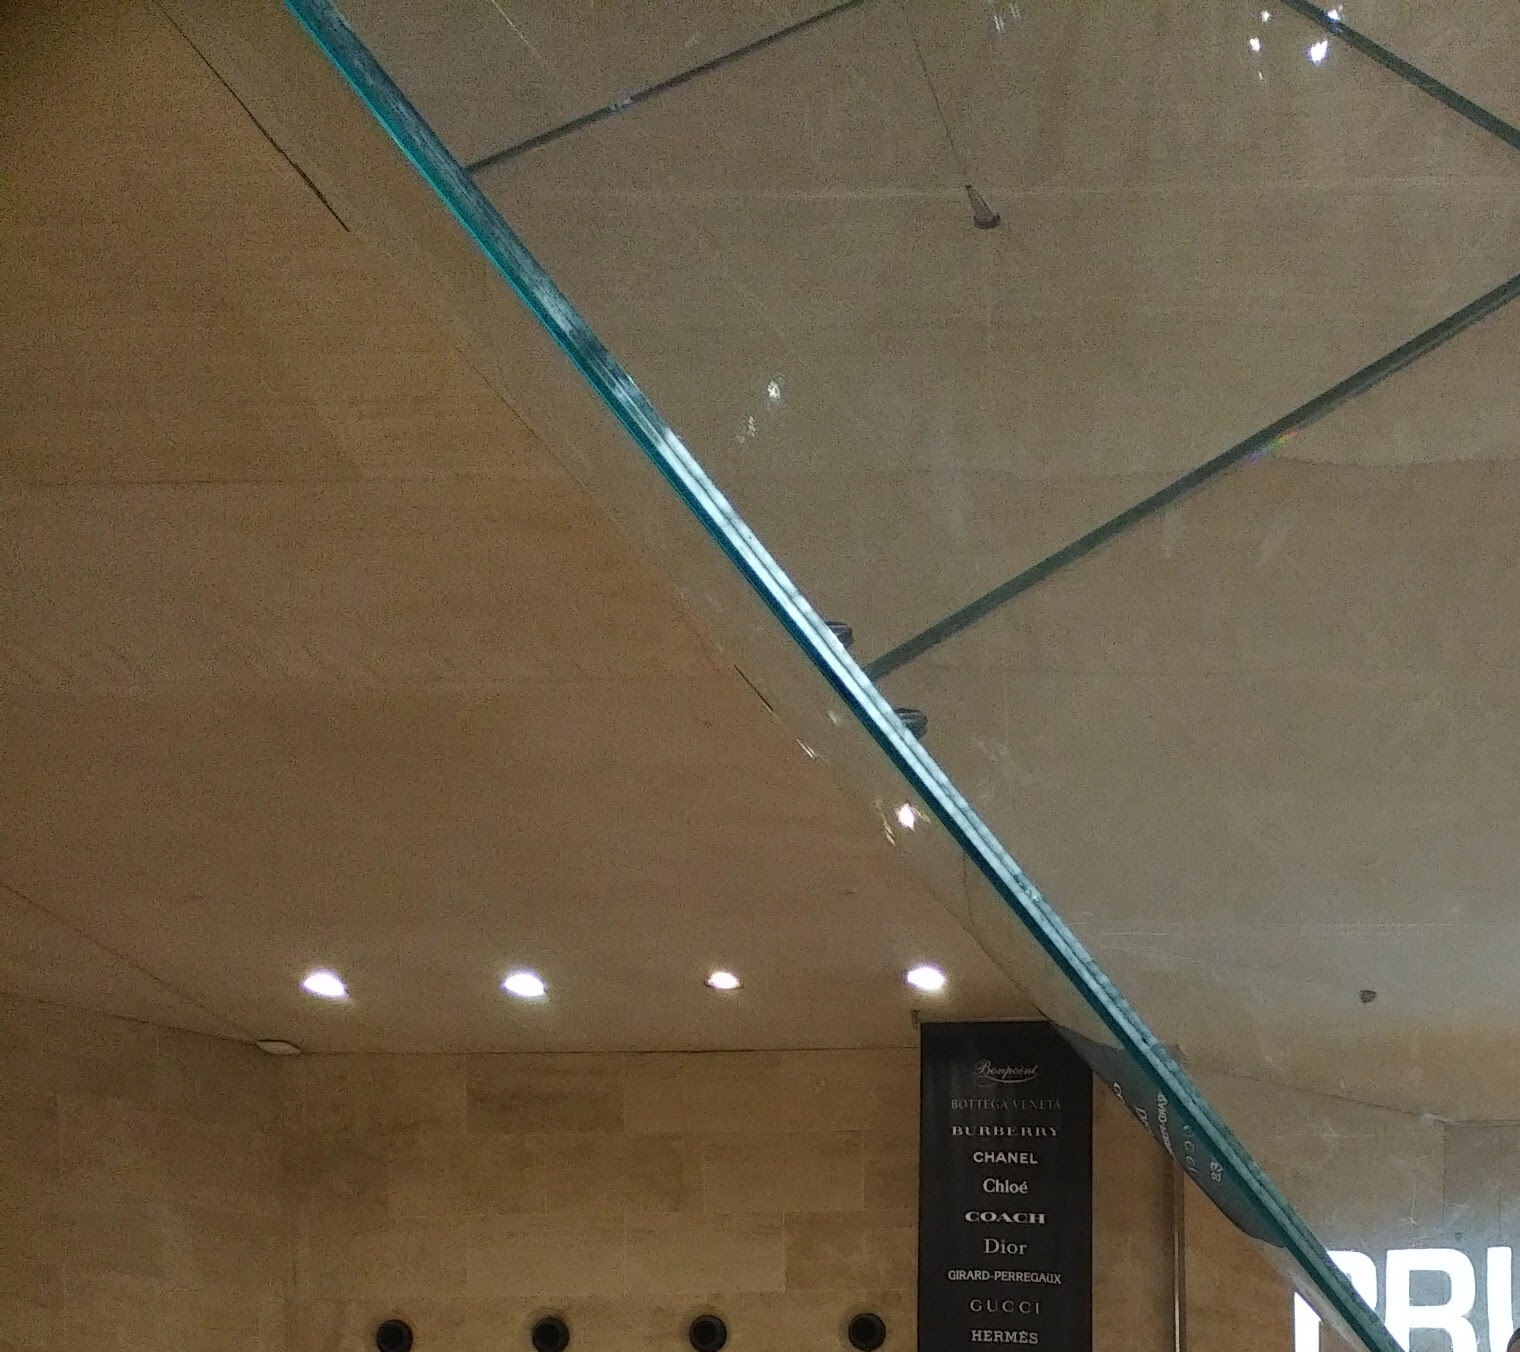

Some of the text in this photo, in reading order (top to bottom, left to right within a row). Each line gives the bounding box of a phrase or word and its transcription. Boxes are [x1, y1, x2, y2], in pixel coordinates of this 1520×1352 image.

[951, 1099, 1062, 1110] BOTTEGA VENETA
[952, 1125, 1060, 1137] BURBERRY
[973, 1151, 1039, 1165] CHANEL
[983, 1178, 1028, 1194] Chloé
[965, 1211, 1046, 1225] COACH
[983, 1239, 1027, 1255] Dior
[948, 1269, 1061, 1285] GIRARD-PERREGAUX
[970, 1299, 1039, 1315] GUCCI
